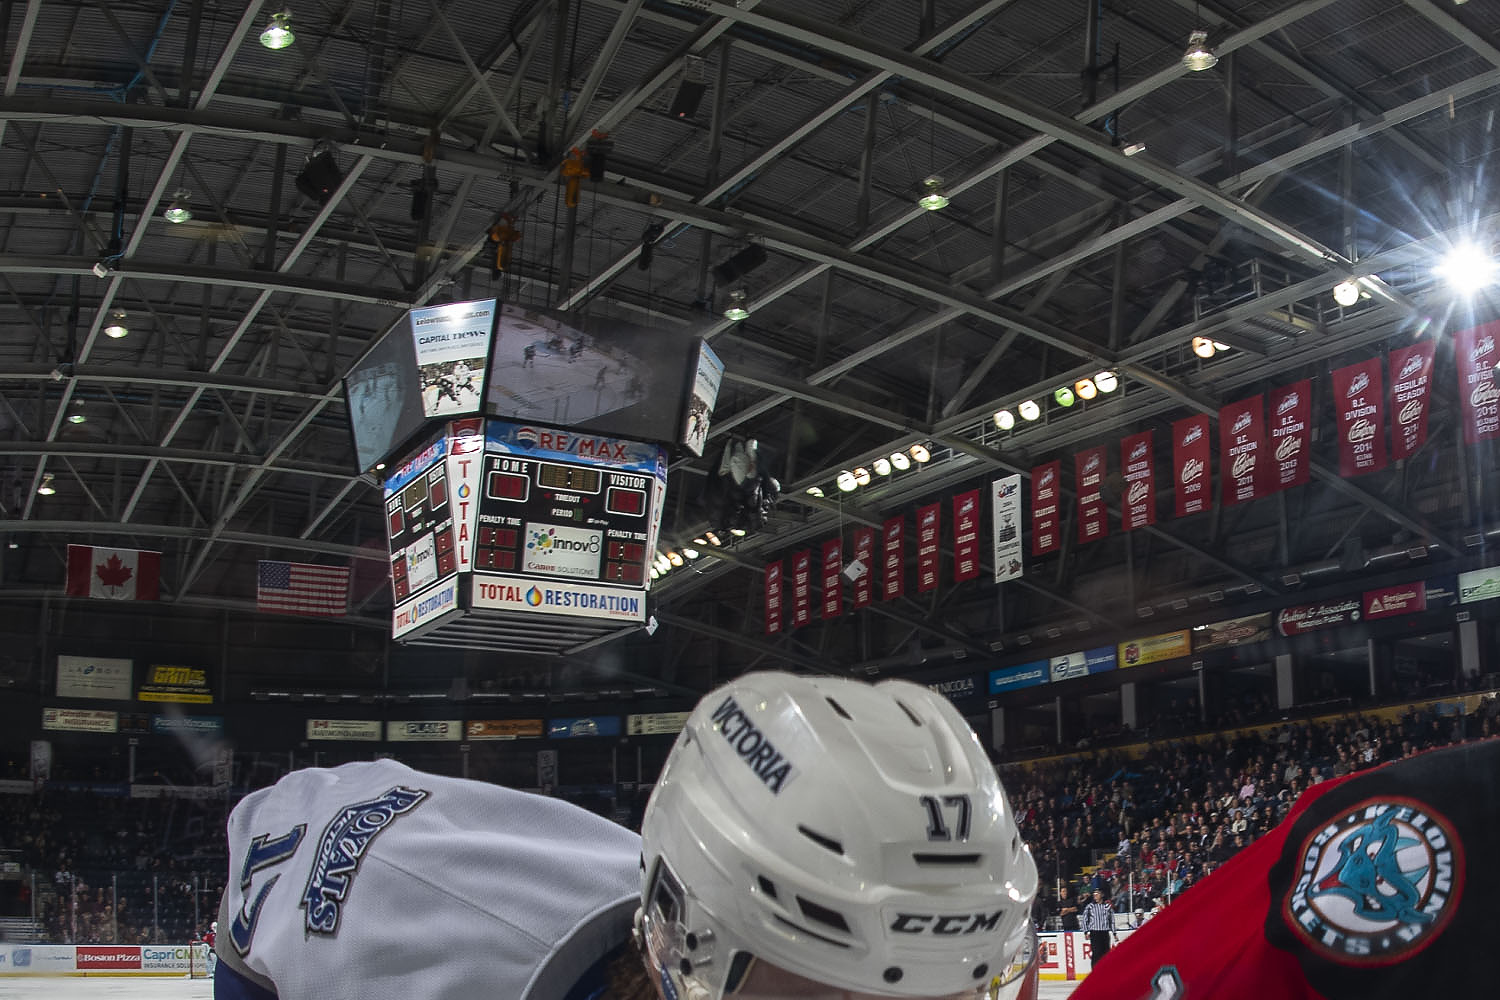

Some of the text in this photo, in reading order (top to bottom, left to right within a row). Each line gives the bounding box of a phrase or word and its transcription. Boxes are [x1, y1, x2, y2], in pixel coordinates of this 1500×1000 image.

[419, 333, 451, 345] CAPITAL
[1394, 376, 1428, 393] REGULAR
[1397, 387, 1426, 402] SEASON
[1345, 405, 1377, 421] DIVISION
[1273, 422, 1304, 437] DIVISION
[540, 432, 628, 460] RE/MAX
[1229, 441, 1258, 456] DIVISION
[492, 458, 529, 473] HOME
[610, 474, 645, 489] VISITOR
[479, 514, 505, 524] PENALTY
[552, 508, 574, 517] PERIOD
[607, 529, 632, 540] PENALTY
[479, 583, 639, 613] TOTAL RESTORATION
[940, 677, 974, 693] NICOLA
[710, 695, 794, 796] VICTORIA
[920, 794, 973, 842] 17
[311, 806, 358, 893] VICTORIA
[303, 785, 434, 938] ROYALS
[228, 822, 308, 958] 17
[890, 910, 1006, 935] CCM
[84, 953, 141, 962] Boston Pizza
